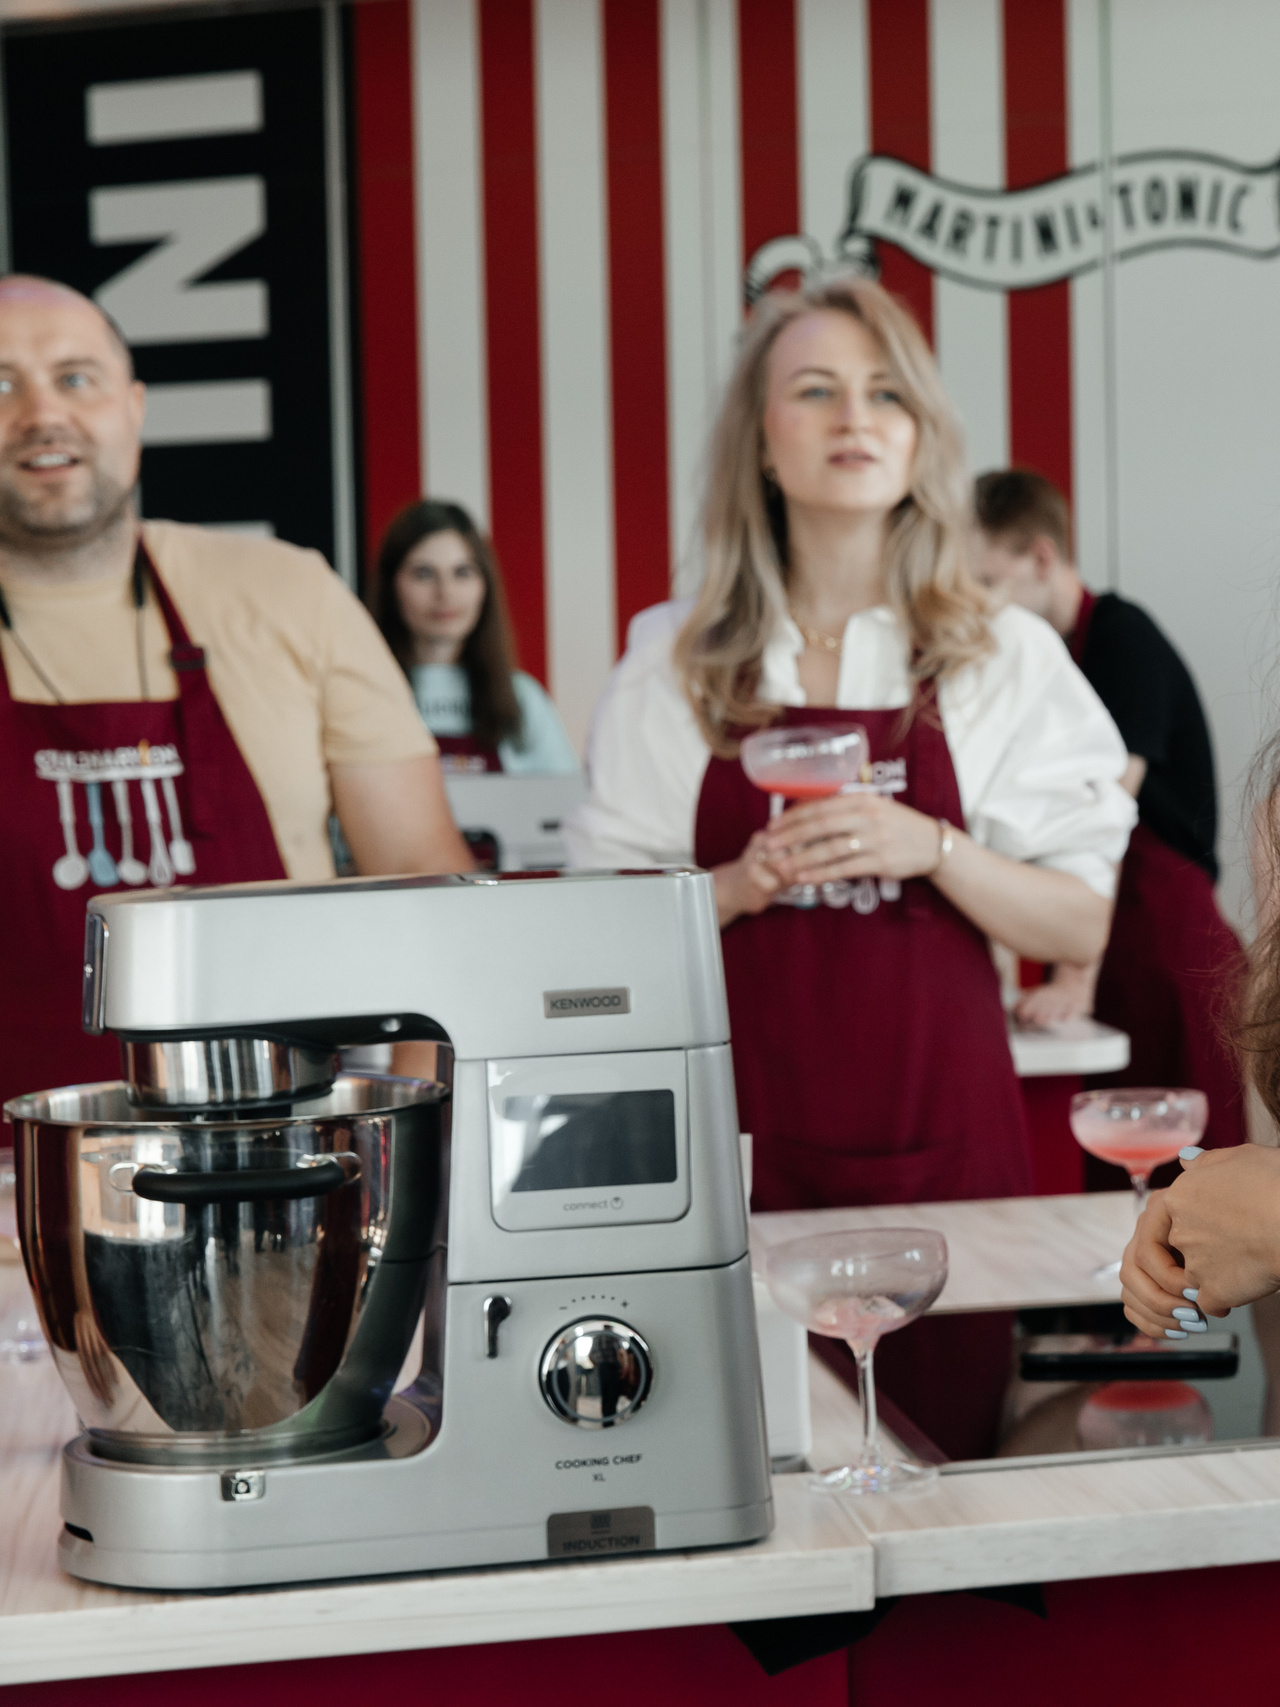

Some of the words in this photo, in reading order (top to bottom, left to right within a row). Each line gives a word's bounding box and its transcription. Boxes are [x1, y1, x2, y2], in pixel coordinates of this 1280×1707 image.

[885, 183, 1081, 264] MARTINI
[1112, 175, 1255, 234] TONIC
[550, 995, 621, 1010] KENWOOD
[562, 1200, 608, 1212] connect
[555, 1456, 609, 1470] COOKING
[612, 1453, 642, 1465] CHEF
[592, 1473, 605, 1482] XL
[563, 1536, 640, 1550] INDUCTION
